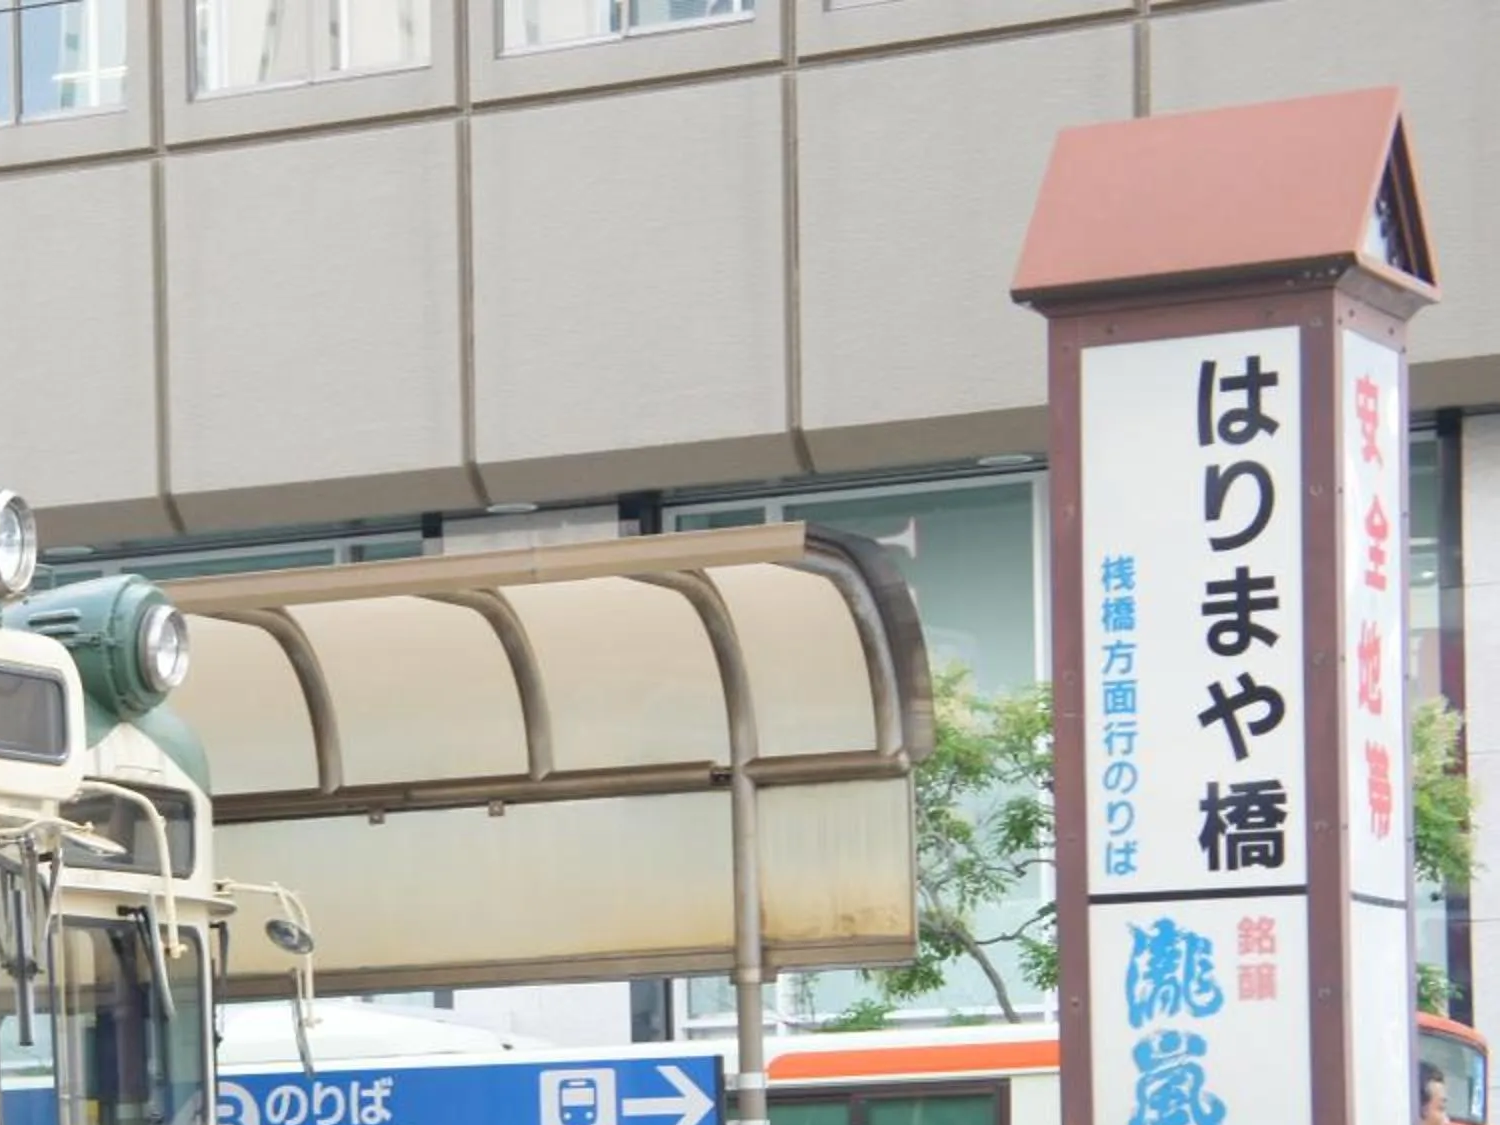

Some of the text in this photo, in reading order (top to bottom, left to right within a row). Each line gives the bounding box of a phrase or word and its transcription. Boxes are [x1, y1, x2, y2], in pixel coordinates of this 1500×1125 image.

[1101, 556, 1139, 876] 桟橋方面行のりば
[1196, 355, 1288, 872] はりまや橋
